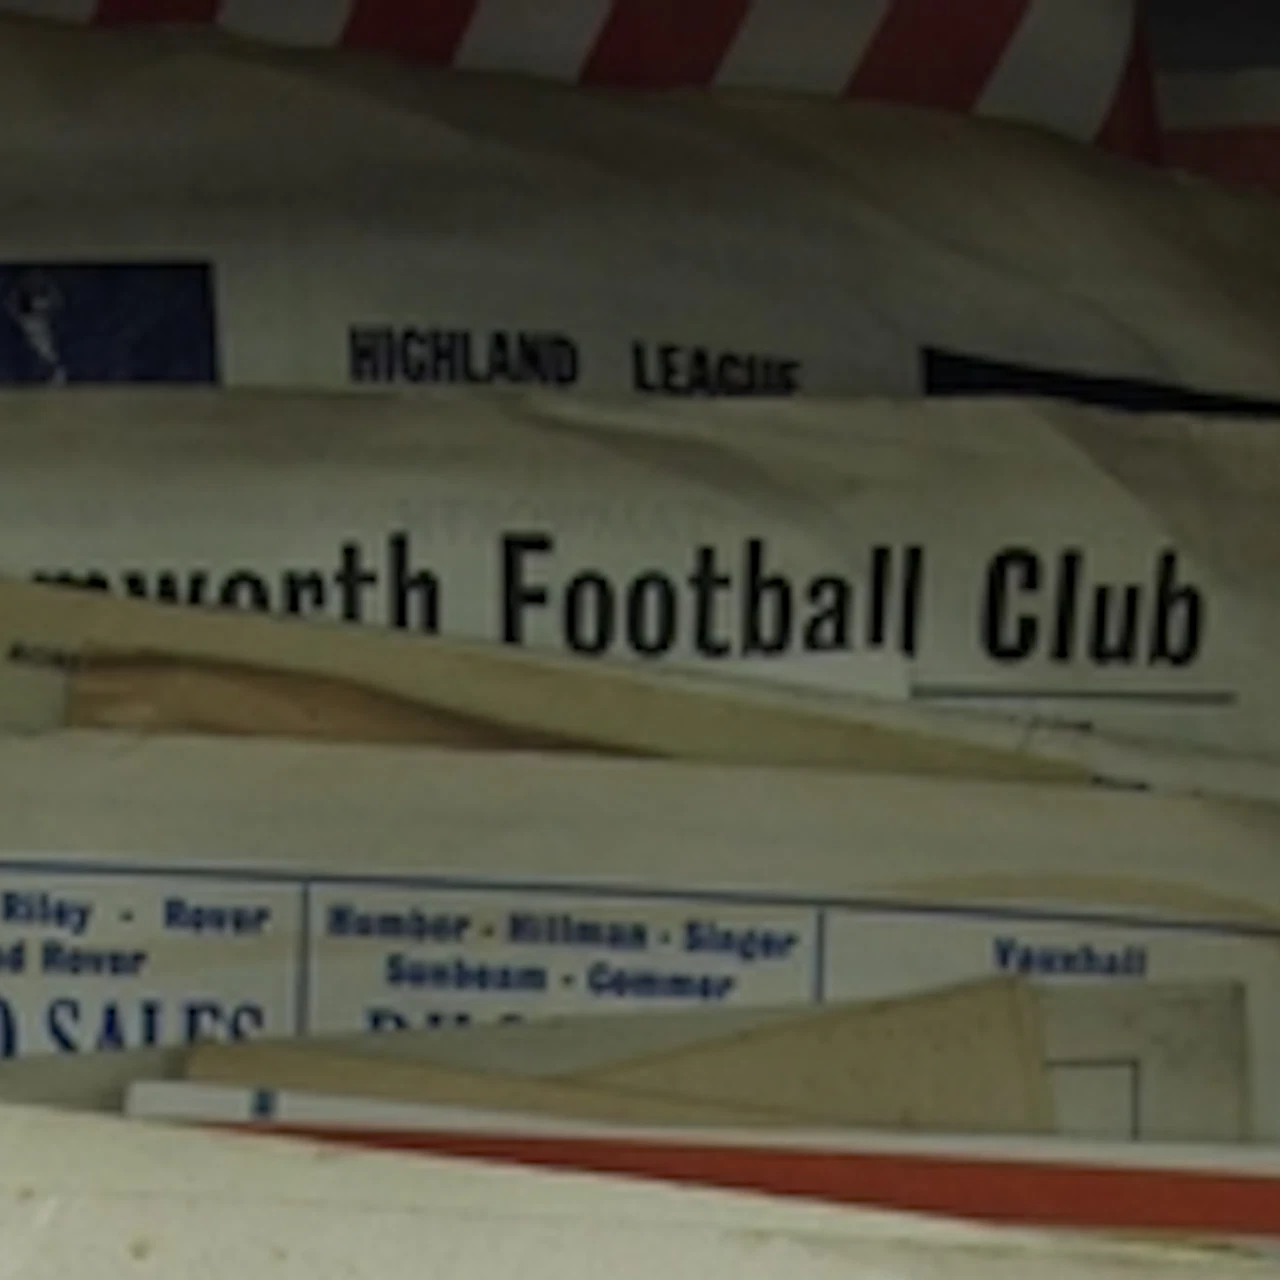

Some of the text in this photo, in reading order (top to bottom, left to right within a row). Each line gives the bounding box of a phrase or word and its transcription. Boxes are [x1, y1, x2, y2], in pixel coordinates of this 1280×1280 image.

[349, 327, 580, 389] HIGHLAND
[501, 533, 924, 658] Football
[982, 548, 1202, 667] Club
[1, 891, 92, 942] Riley
[165, 898, 270, 936] Rover
[328, 906, 472, 942] Humber
[508, 913, 647, 949] Hillman
[683, 918, 799, 961] Singer
[42, 941, 148, 976] Rover
[386, 953, 546, 990] Sunbeam
[588, 962, 735, 1000] Commer
[992, 937, 1148, 977] Vauxhall
